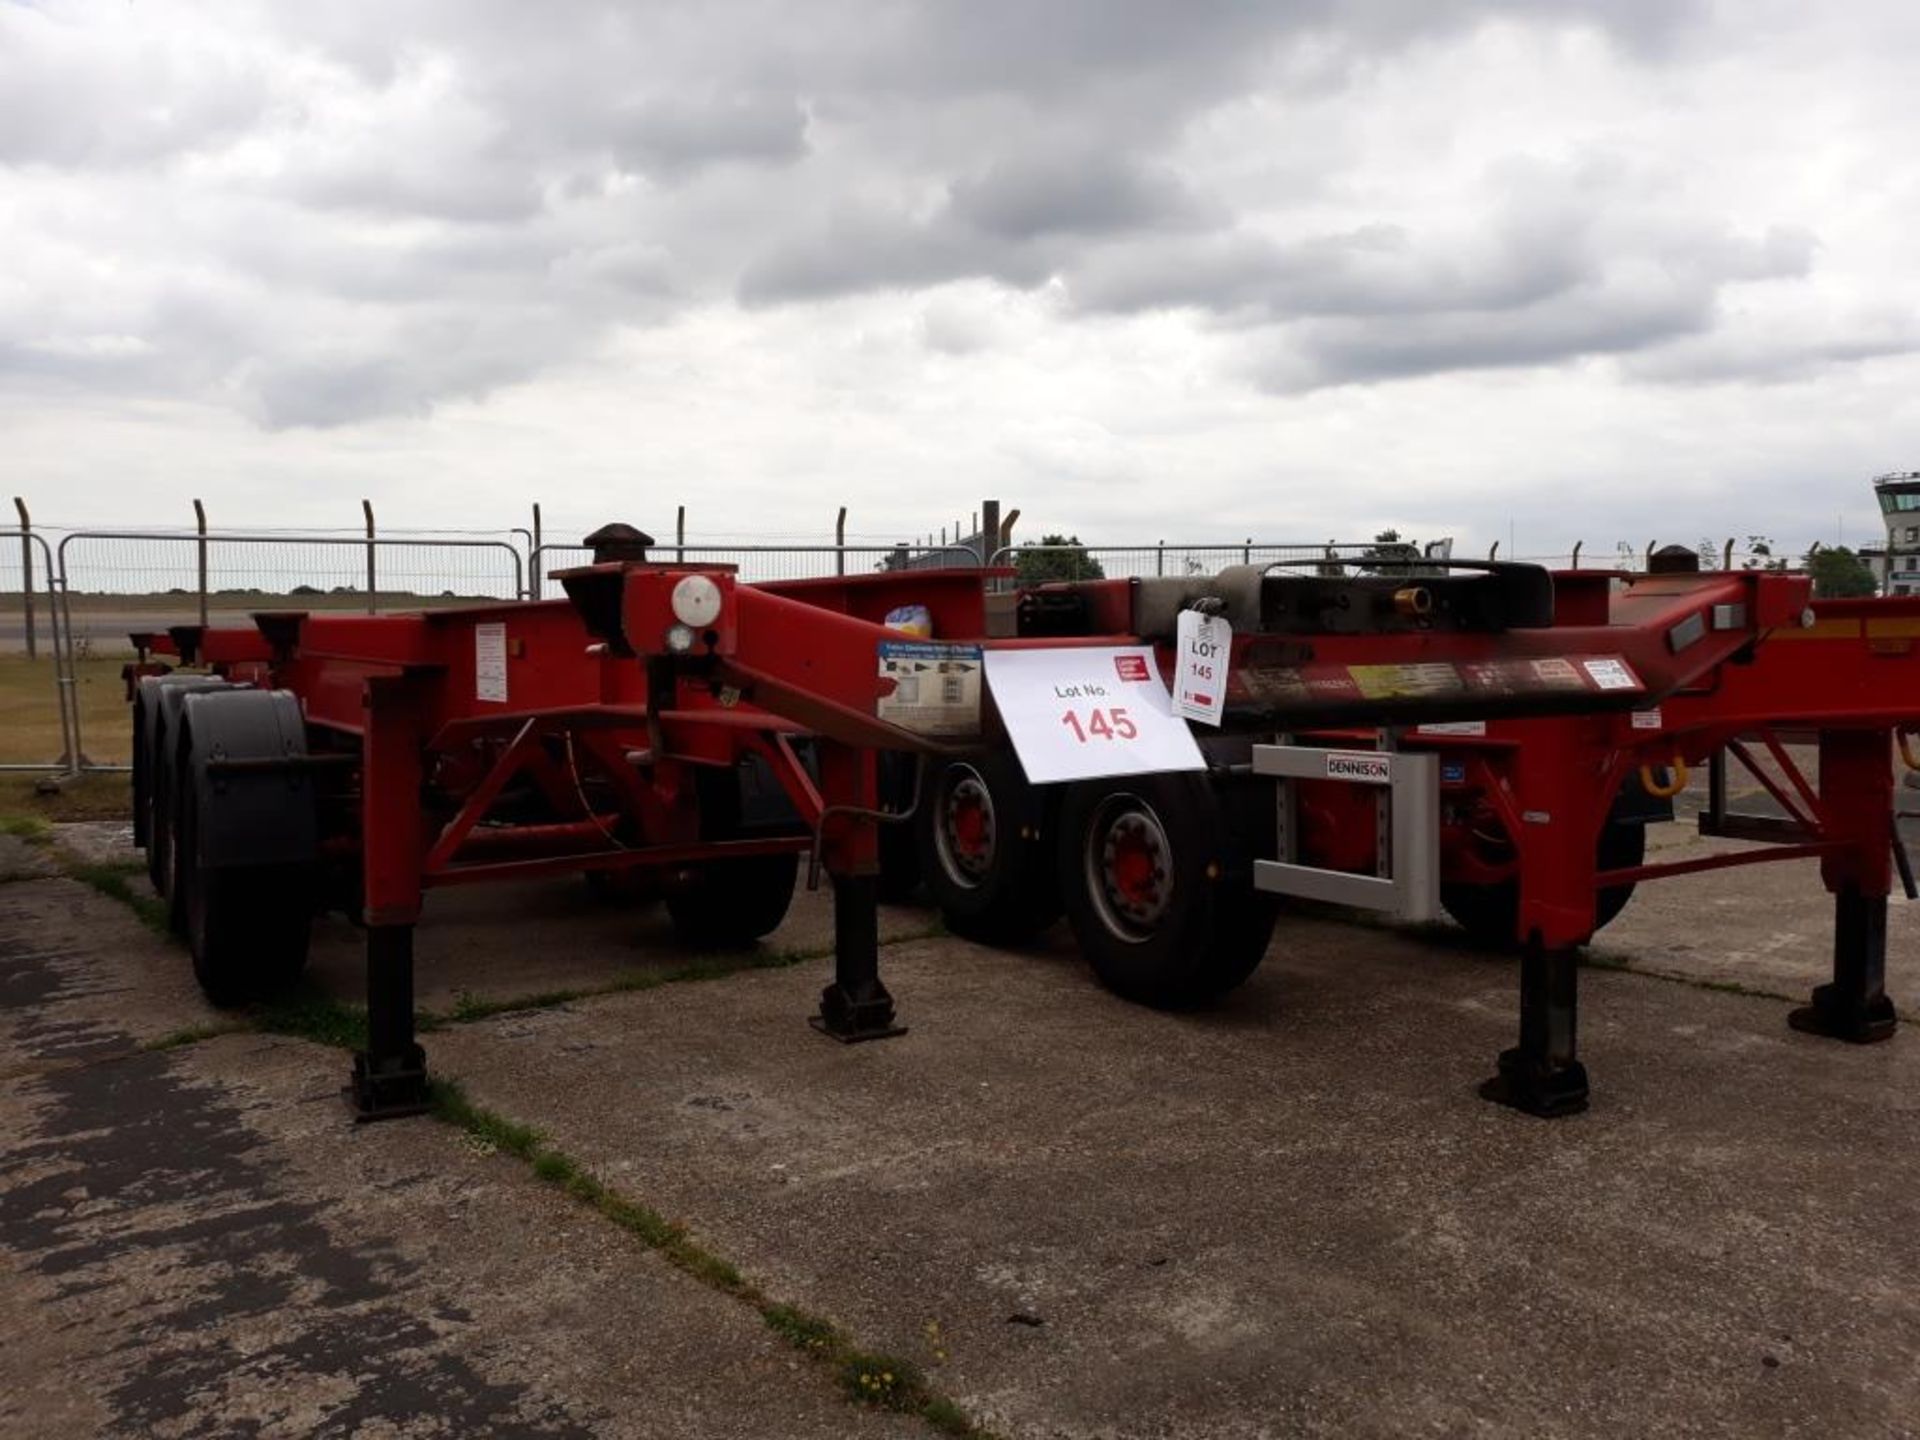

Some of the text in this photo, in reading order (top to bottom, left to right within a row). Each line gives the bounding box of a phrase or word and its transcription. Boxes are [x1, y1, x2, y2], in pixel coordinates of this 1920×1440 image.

[1191, 641, 1217, 658] LOT
[1191, 663, 1212, 680] 145
[1054, 686, 1081, 698] Lot
[1062, 708, 1137, 743] 145
[1328, 760, 1388, 776] DENNISON
